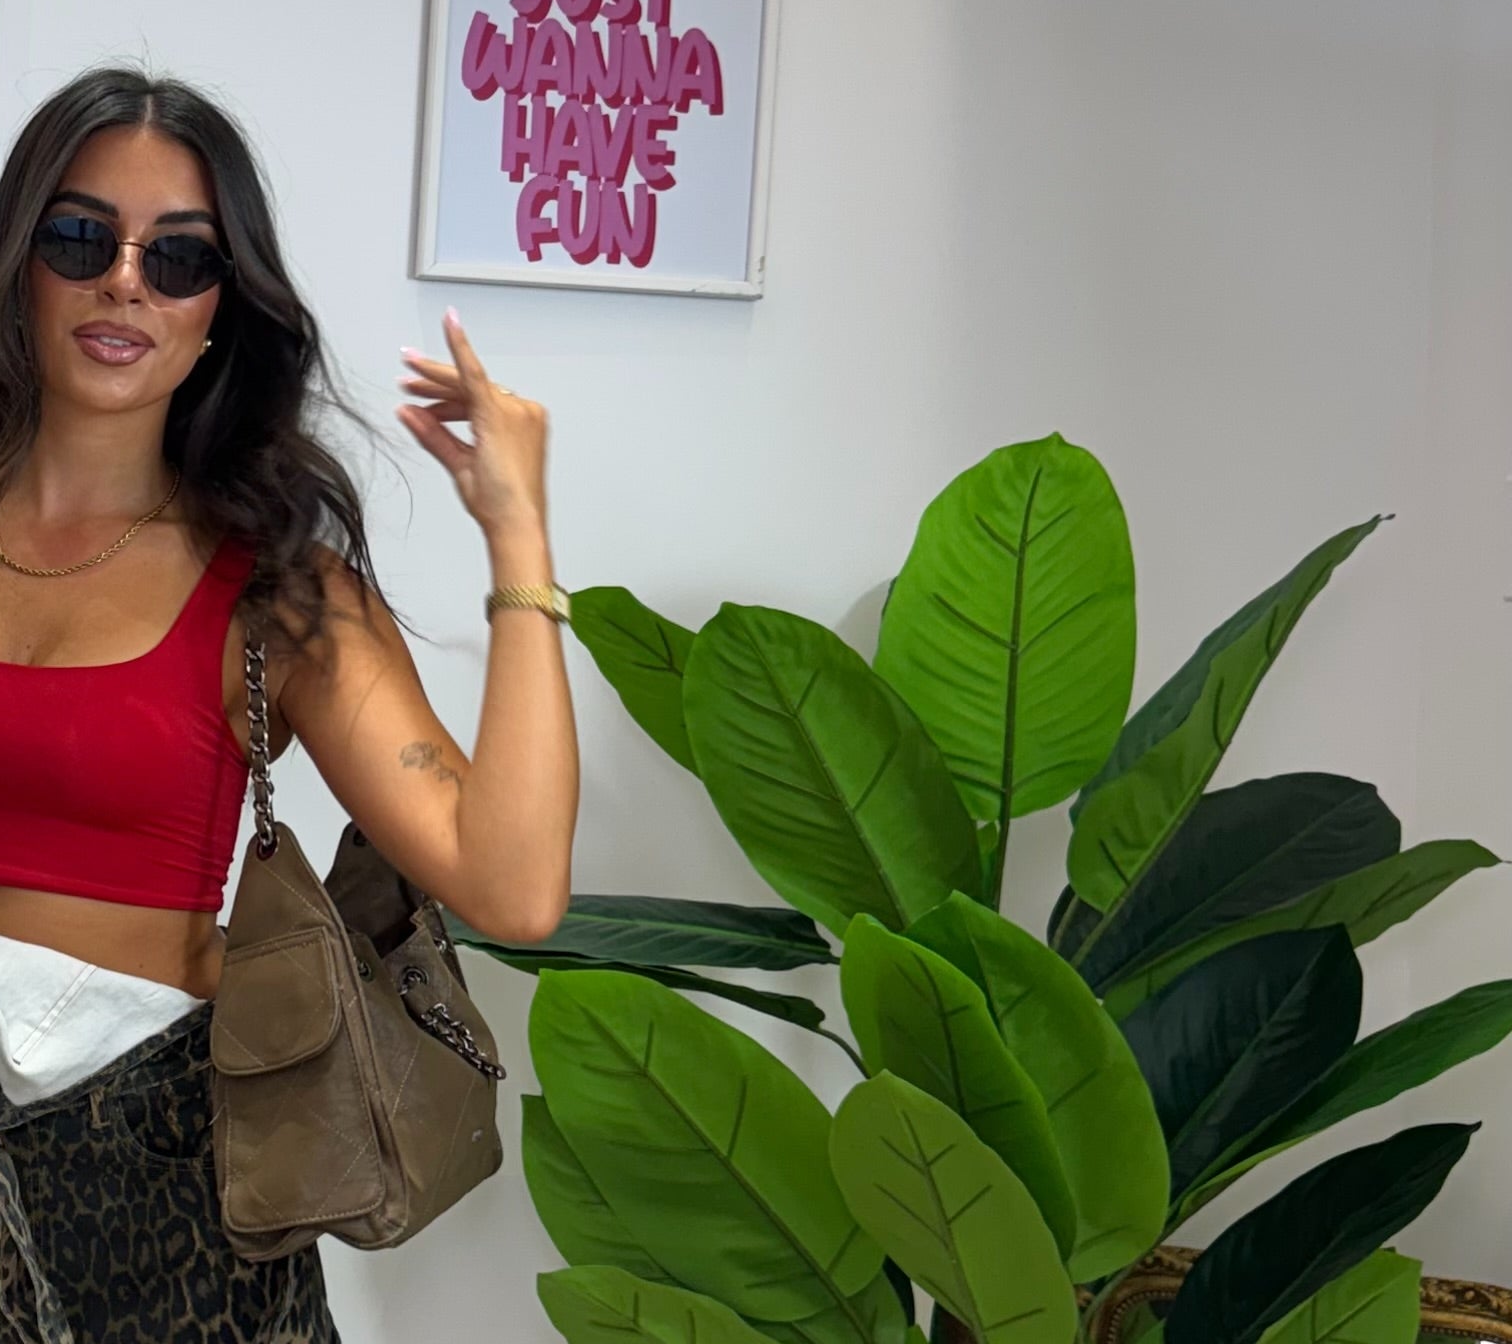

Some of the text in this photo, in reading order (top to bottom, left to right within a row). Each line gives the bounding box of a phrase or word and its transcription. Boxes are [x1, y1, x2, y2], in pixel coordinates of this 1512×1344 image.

[462, 11, 724, 115] WANNA
[501, 94, 678, 192] HAVE
[516, 174, 657, 268] FUN
